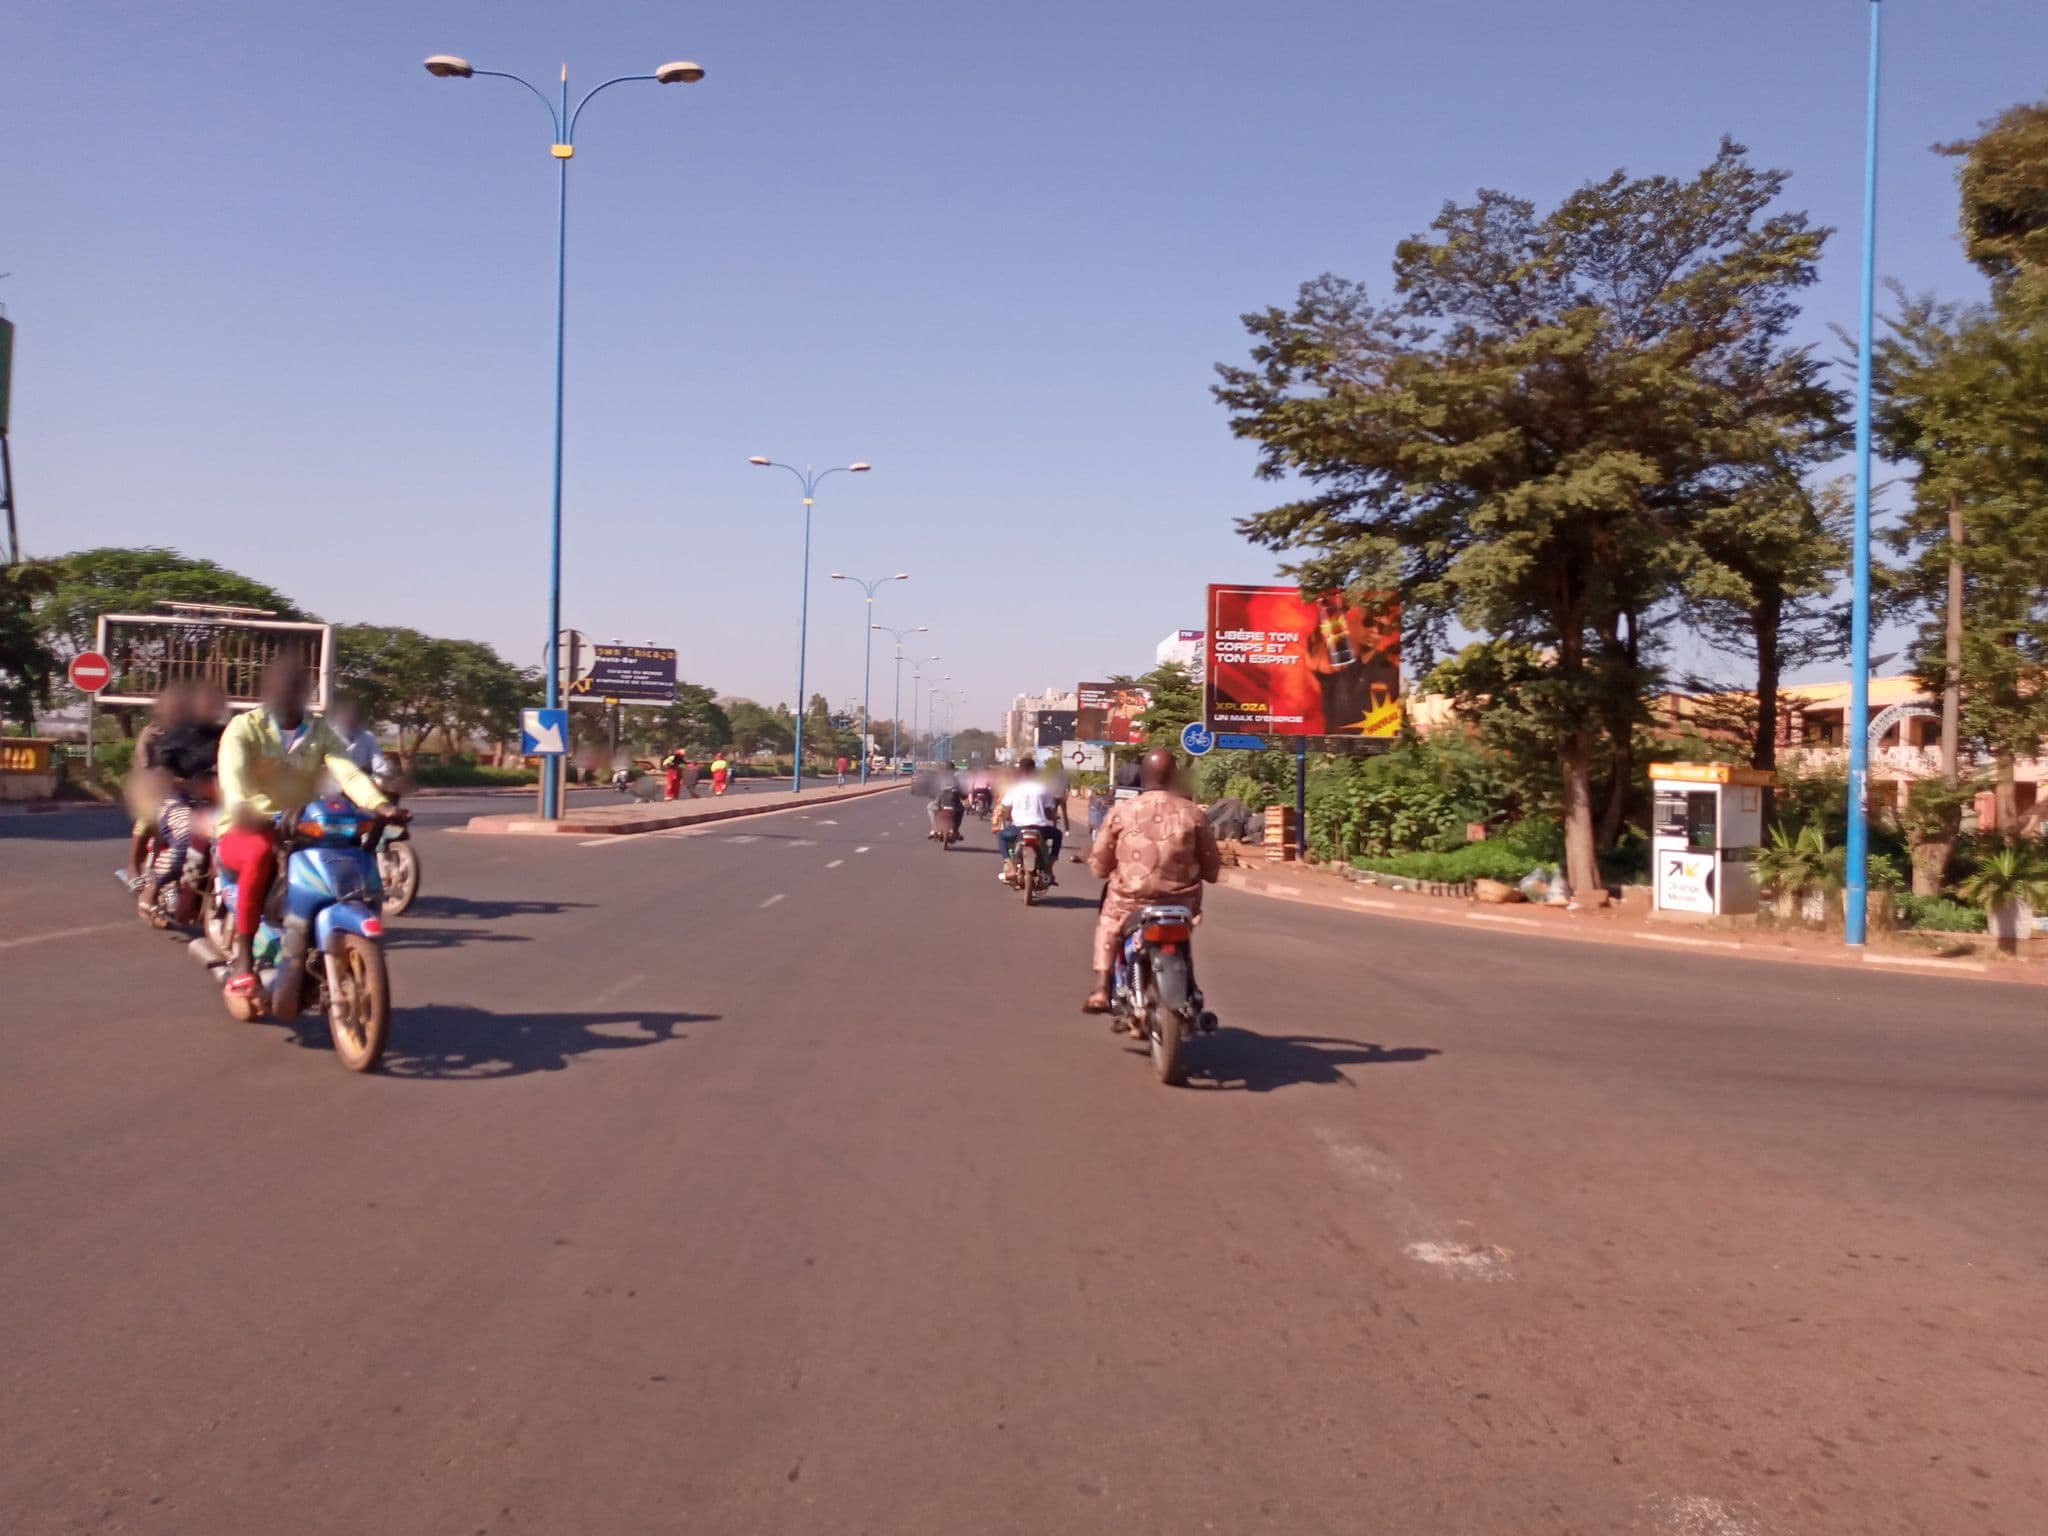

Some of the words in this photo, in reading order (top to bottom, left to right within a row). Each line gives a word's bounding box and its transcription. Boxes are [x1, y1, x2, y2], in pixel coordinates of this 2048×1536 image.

[1268, 632, 1299, 642] TON
[1215, 642, 1264, 652] CORPS
[1267, 643, 1286, 653] ET
[1214, 653, 1246, 663] TON
[1249, 654, 1299, 665] ESPRIT
[1215, 702, 1268, 712] XPLOZA
[1229, 714, 1254, 722] MAX
